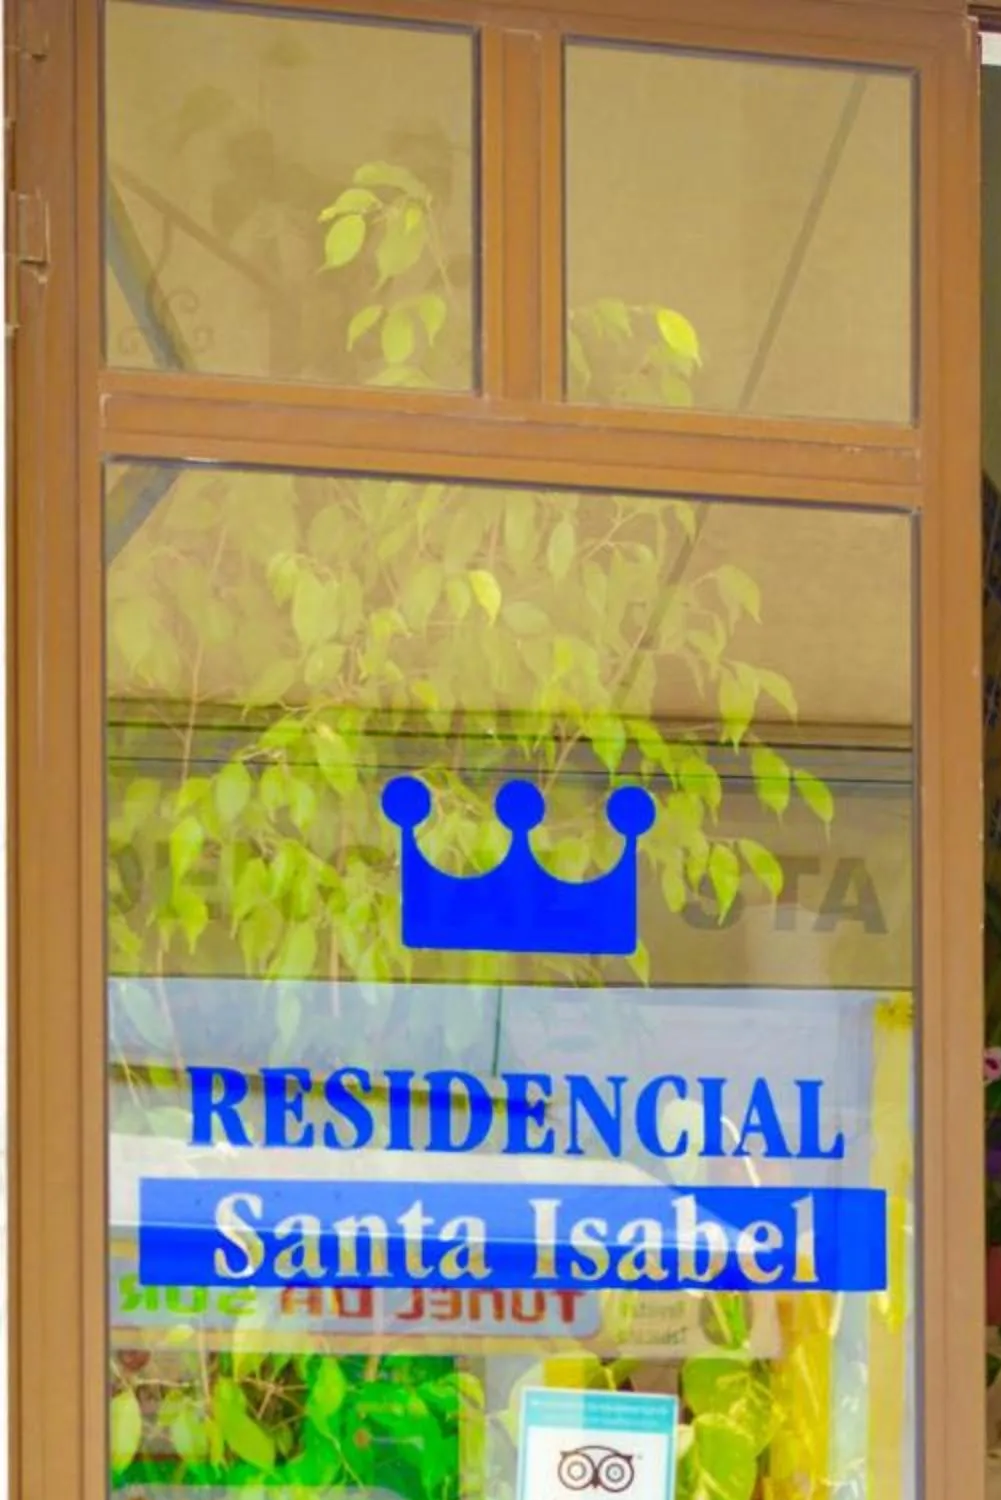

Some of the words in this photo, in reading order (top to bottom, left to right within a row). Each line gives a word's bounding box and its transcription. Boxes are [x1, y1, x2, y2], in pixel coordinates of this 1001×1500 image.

[187, 1066, 845, 1161] RESIDENCIAL
[213, 1193, 491, 1282] Santa
[528, 1194, 819, 1284] Isabel
